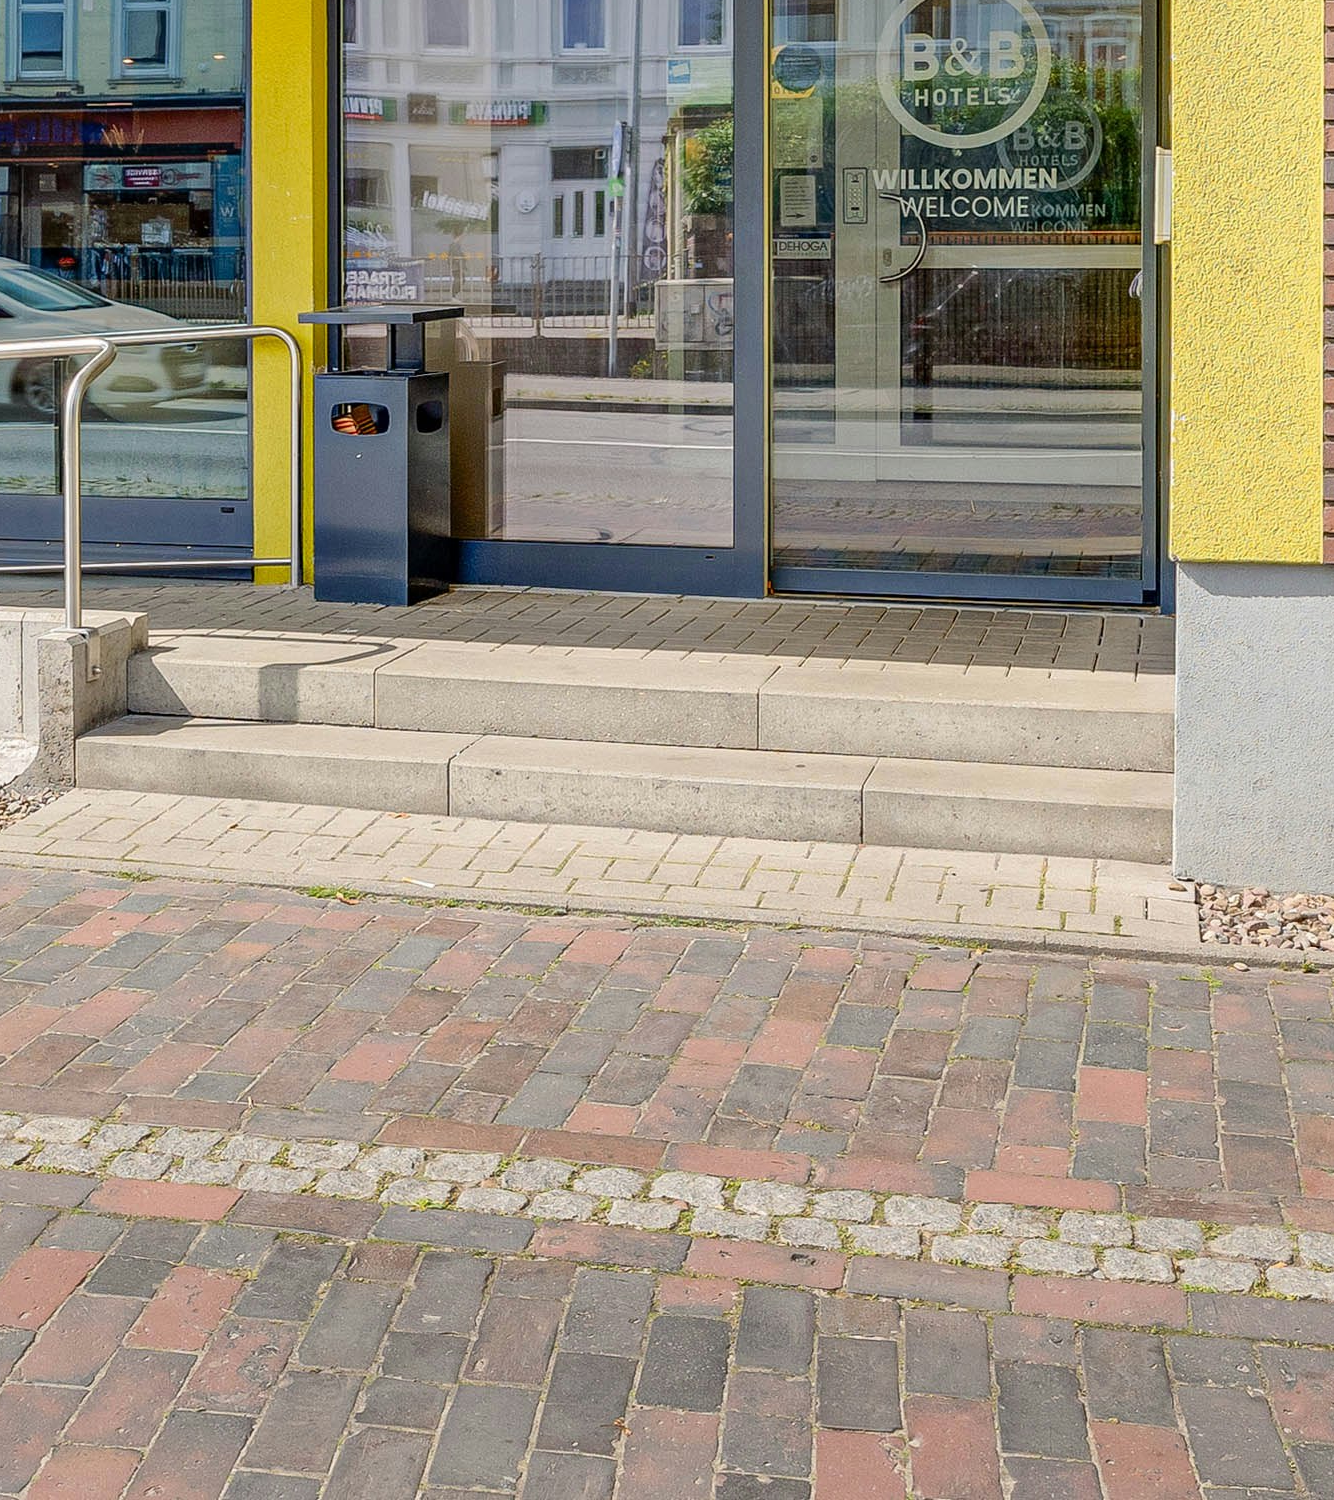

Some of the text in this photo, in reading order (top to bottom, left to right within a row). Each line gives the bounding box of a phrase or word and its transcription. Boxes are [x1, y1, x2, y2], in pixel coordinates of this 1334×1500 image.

[903, 30, 1027, 82] B&B
[914, 87, 1013, 108] HOTELS
[1013, 120, 1087, 151] B&B
[1019, 154, 1079, 167] HOTELS
[872, 168, 1058, 190] WILLKOMMEN
[900, 196, 1030, 218] WELCOME
[1030, 203, 1106, 218] KOMMEN
[1010, 220, 1089, 234] WELCOME
[779, 240, 828, 252] DEHOGA
